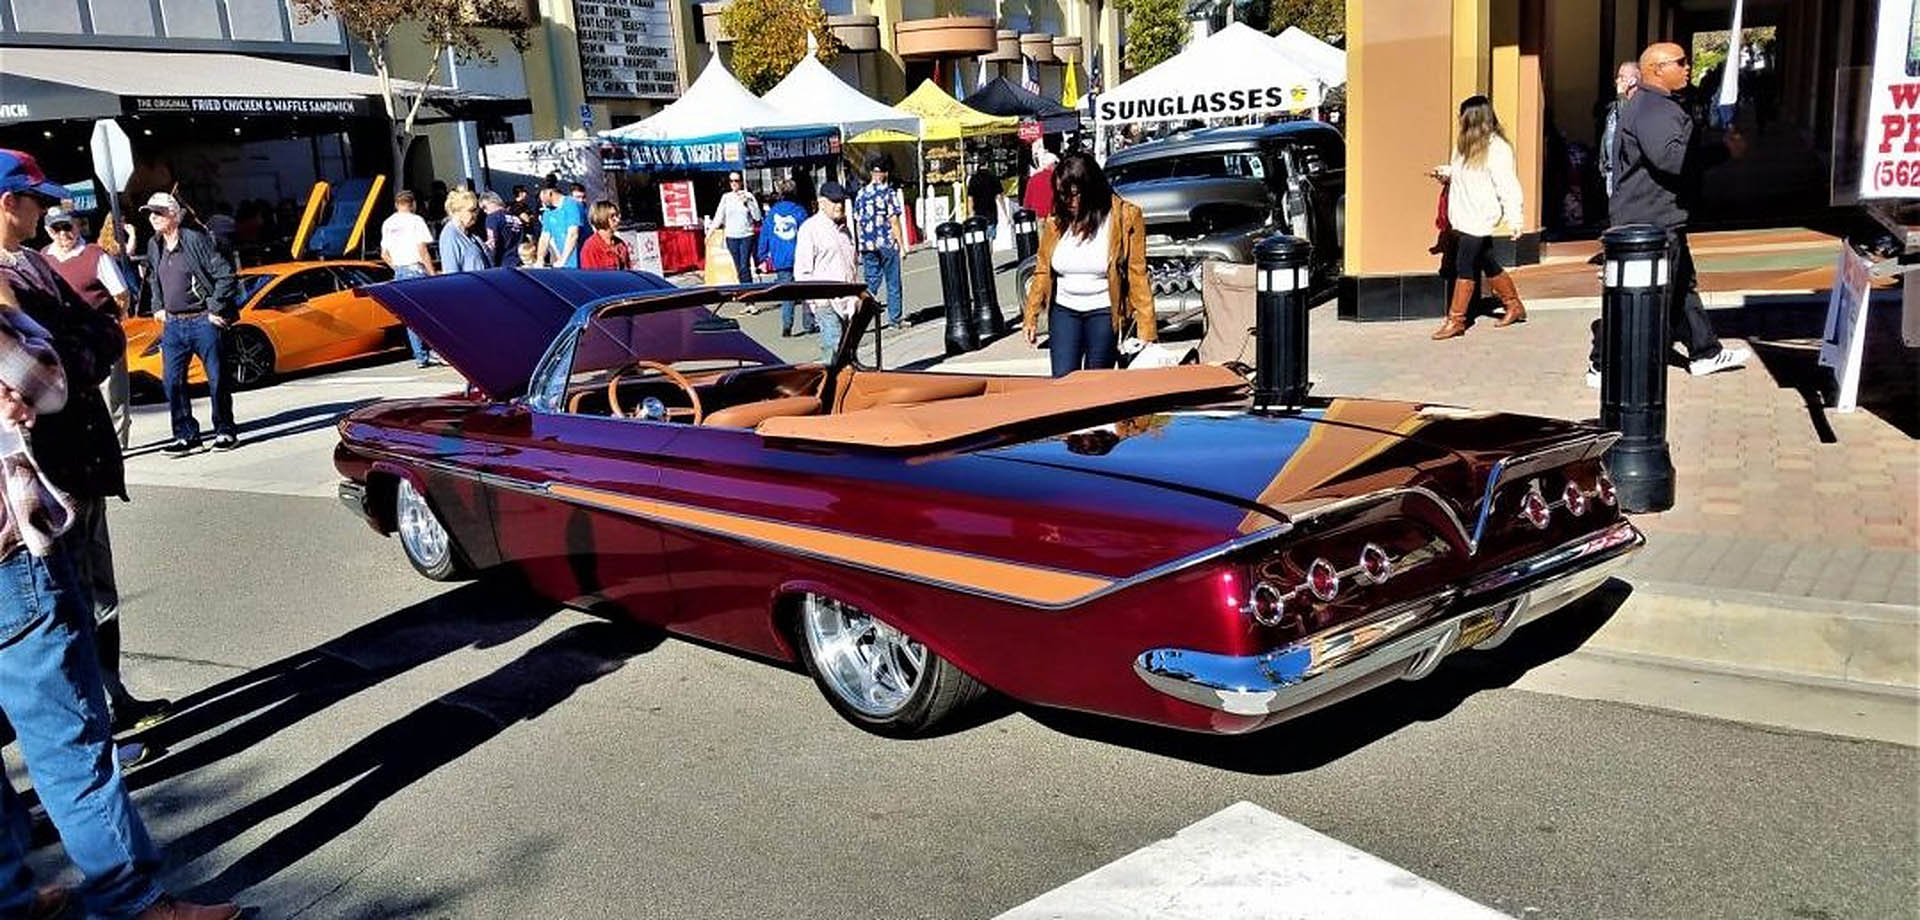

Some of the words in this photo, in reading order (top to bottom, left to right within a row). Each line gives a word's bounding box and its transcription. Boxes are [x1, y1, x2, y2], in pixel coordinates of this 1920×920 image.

[137, 98, 151, 108] THE
[192, 98, 221, 112] FRIED
[223, 99, 263, 112] CHICKEN
[273, 100, 308, 112] WAFFLE
[309, 100, 355, 113] SANDWICH
[1101, 86, 1283, 121] SUNGLASSES
